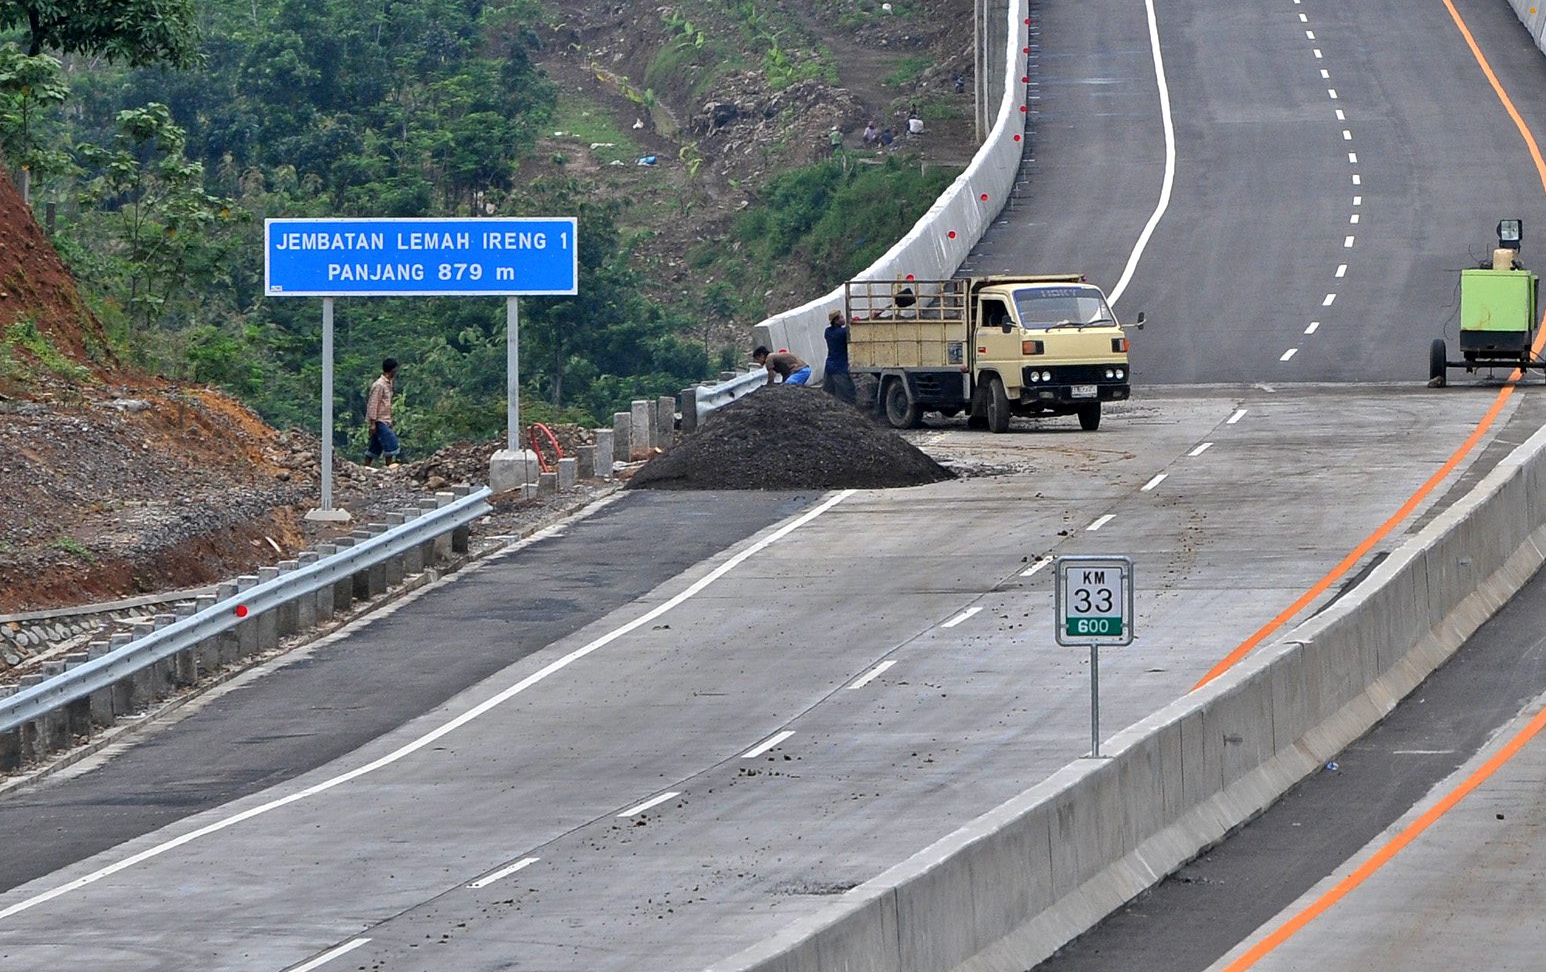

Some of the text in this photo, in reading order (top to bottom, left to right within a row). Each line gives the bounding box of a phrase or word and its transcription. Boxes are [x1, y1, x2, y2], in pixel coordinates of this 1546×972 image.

[276, 232, 567, 250] JEMBATAN LEMAH IRENG 1
[328, 263, 515, 281] PANJANG 879 m
[1083, 571, 1105, 584] KM
[1074, 588, 1113, 613] 33
[1078, 619, 1109, 633] 600
